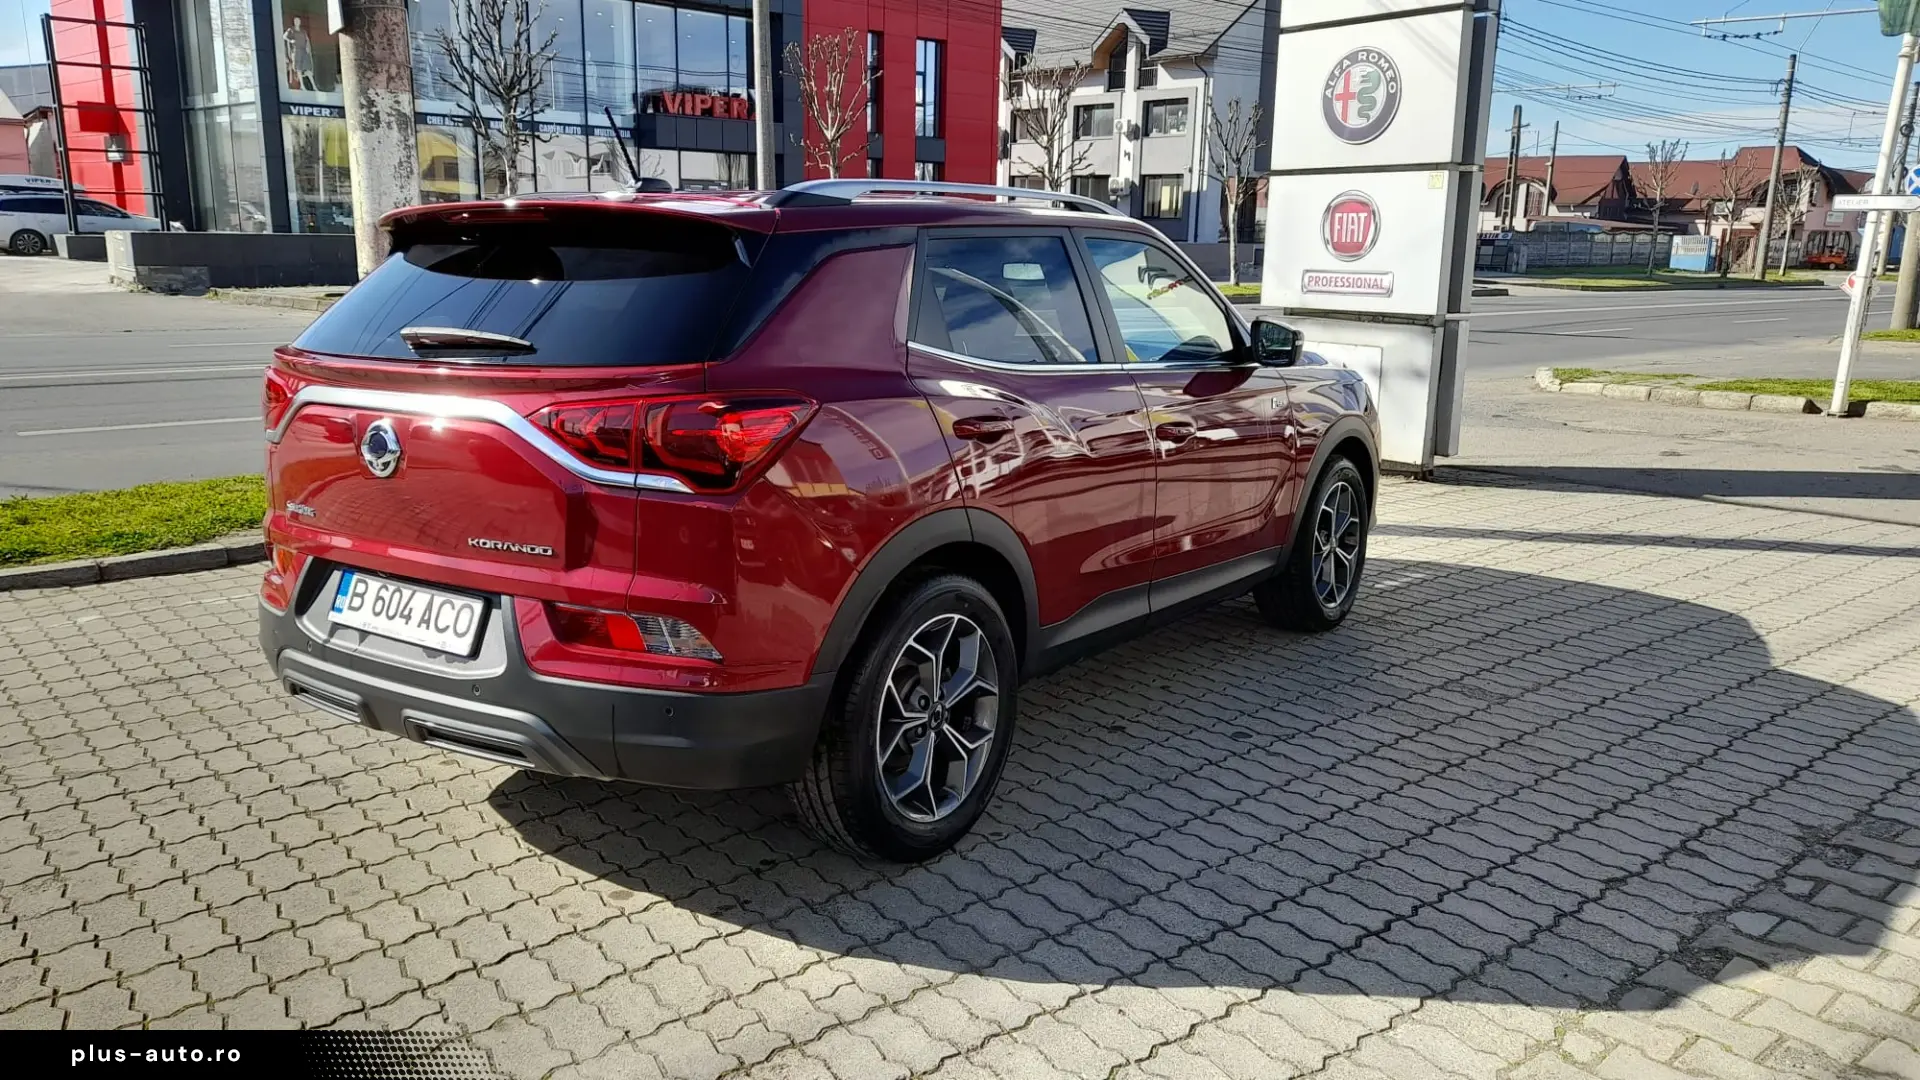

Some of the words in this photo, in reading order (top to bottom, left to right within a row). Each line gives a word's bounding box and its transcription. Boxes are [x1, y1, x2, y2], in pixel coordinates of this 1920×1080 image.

[1325, 58, 1351, 98] ALFA
[1358, 51, 1397, 93] ROMEO
[564, 126, 582, 135] AUTO
[1333, 212, 1368, 243] FIAT
[1307, 275, 1385, 290] PROFESSIONAL
[467, 537, 553, 556] KORANDO
[347, 577, 369, 612] B
[372, 584, 417, 625] 604
[417, 593, 475, 638] ACO
